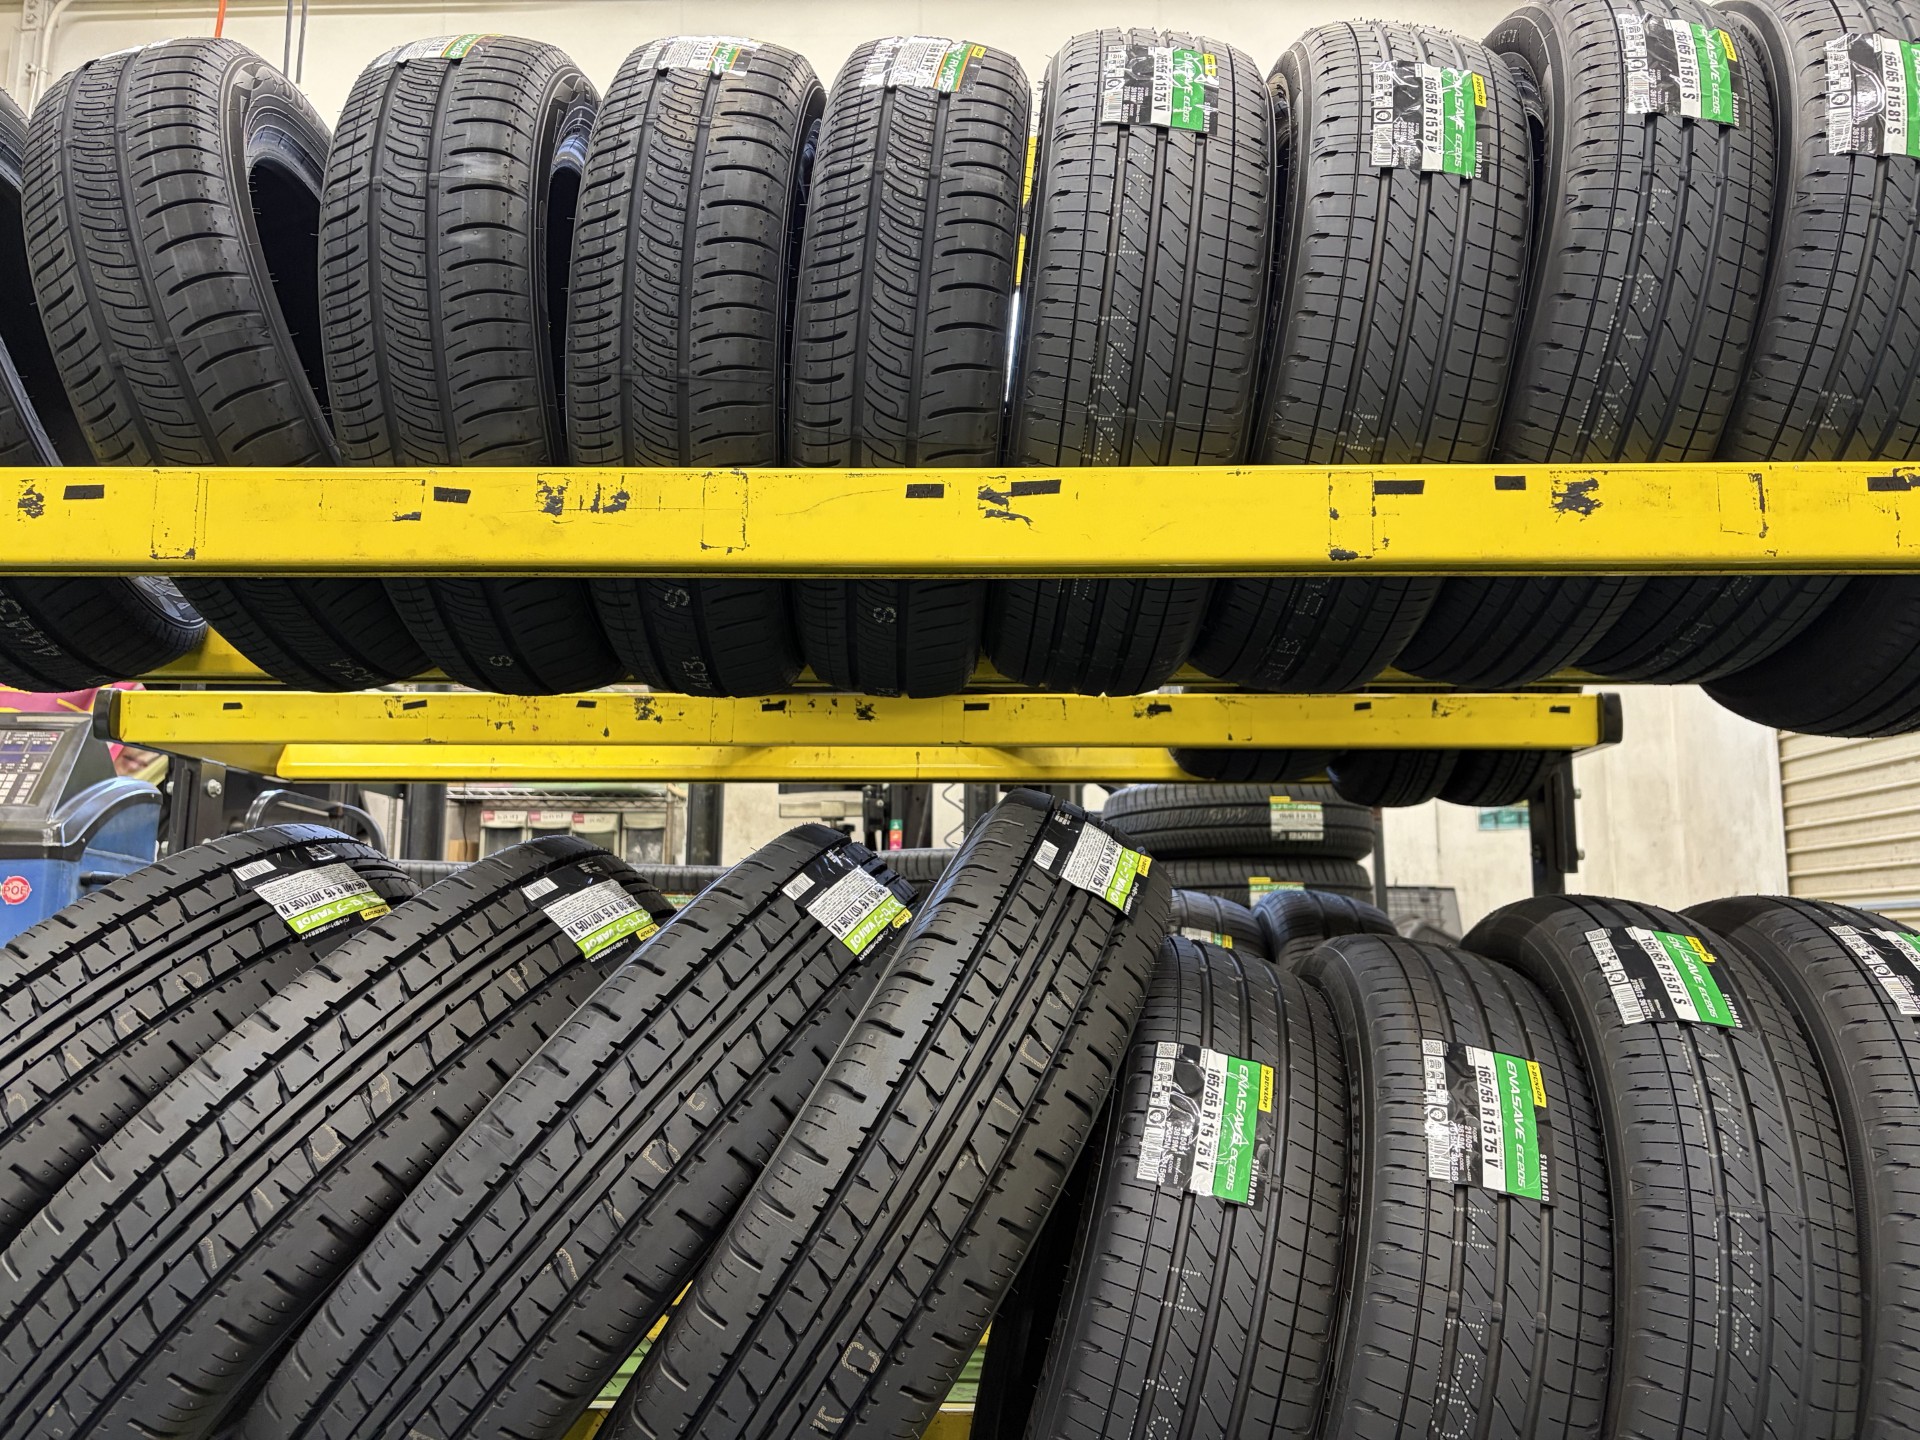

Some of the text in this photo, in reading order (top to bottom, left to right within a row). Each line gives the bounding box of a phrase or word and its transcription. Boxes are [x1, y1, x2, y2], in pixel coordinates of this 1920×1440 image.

[1681, 66, 1694, 75] 15
[1682, 78, 1694, 88] 81
[1888, 96, 1900, 108] 15
[1426, 117, 1437, 126] 15
[1888, 110, 1900, 122] 81
[1426, 130, 1437, 142] 75
[324, 888, 336, 899] 15
[289, 891, 325, 911] 107/105
[860, 899, 871, 912] 15
[279, 904, 290, 915] N
[602, 908, 613, 920] 15
[610, 905, 618, 916] R
[838, 904, 864, 929] 107/105
[576, 912, 605, 934] 107/105
[568, 926, 579, 937] N
[1640, 937, 1666, 962] 165/65
[1662, 973, 1677, 982] 15
[1667, 984, 1681, 994] 81
[1698, 988, 1718, 1019] EC205
[1722, 994, 1743, 1028] STANDARD
[1532, 1071, 1542, 1103] DUNLOP
[1196, 1068, 1220, 1170] 165/55 R 15 75 V
[1478, 1067, 1498, 1168] 165/55 R 15 75 V
[1506, 1060, 1526, 1189] ENASAVE EC205
[1248, 1159, 1259, 1206] STANDARD
[1540, 1154, 1549, 1202] STANDARD
